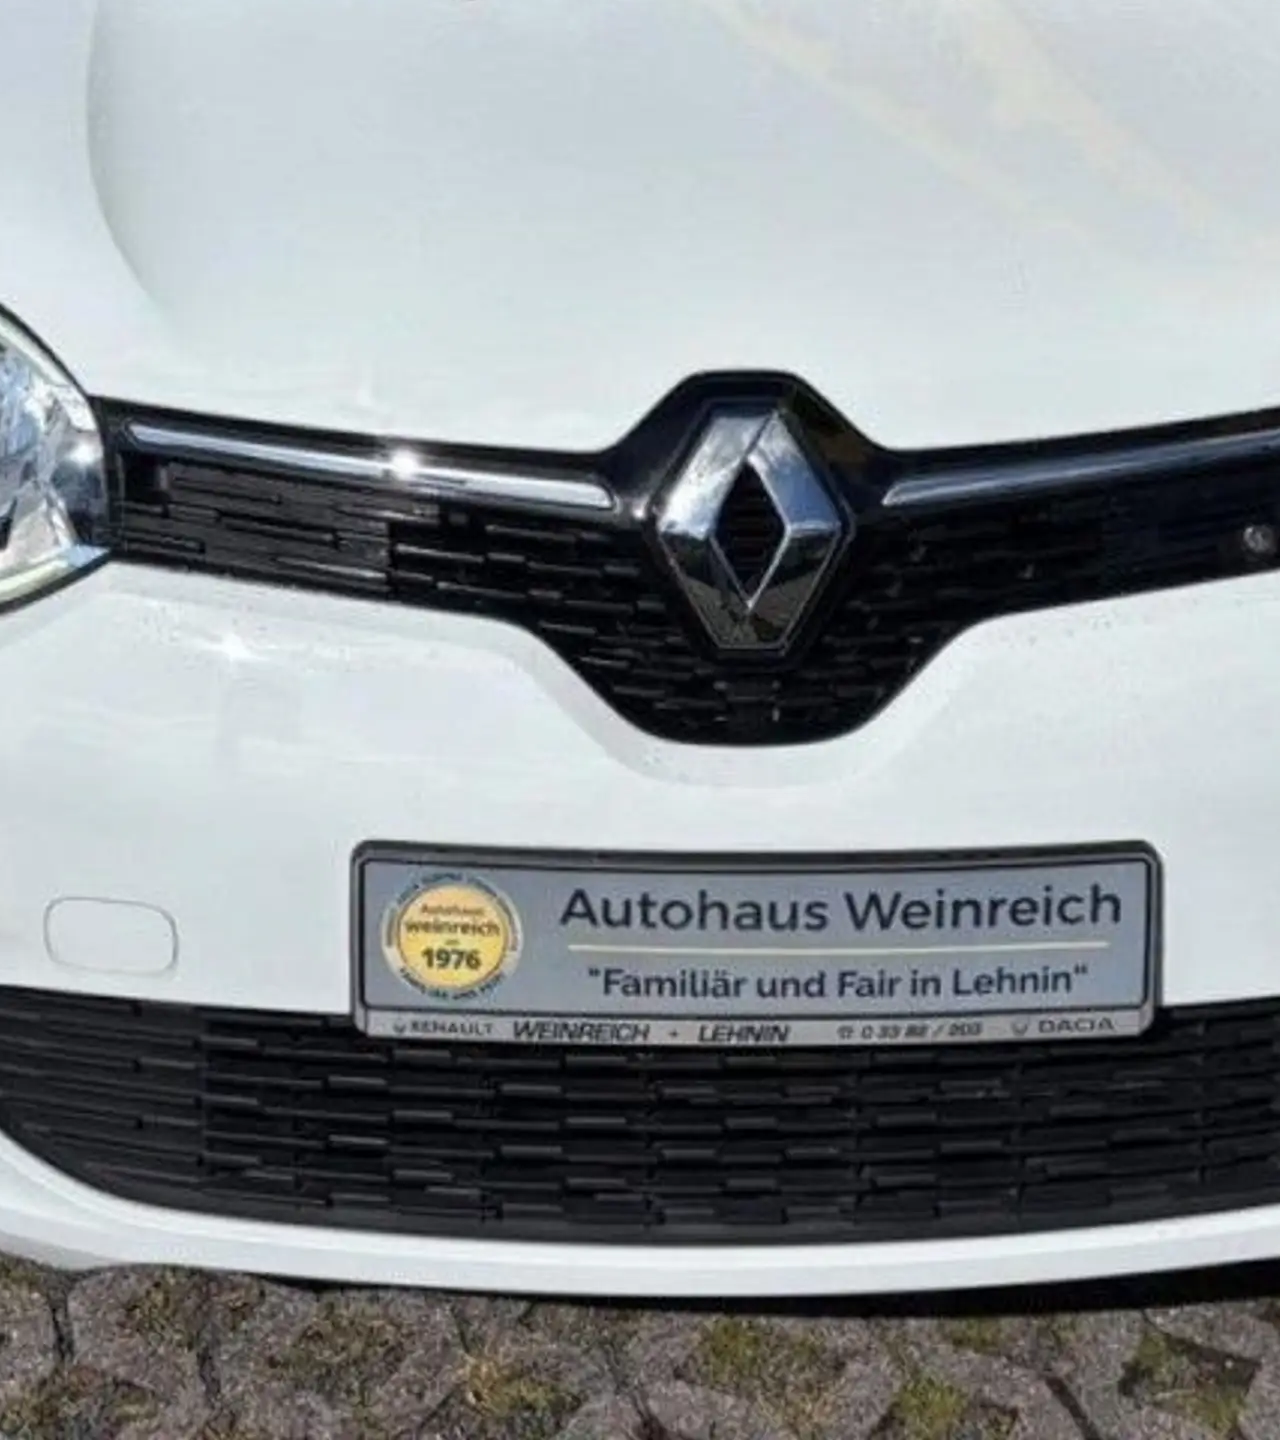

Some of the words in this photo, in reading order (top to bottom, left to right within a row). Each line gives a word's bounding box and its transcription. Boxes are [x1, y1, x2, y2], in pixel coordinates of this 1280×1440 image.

[560, 887, 829, 932] Autohaus
[843, 882, 1122, 931] Weinreich
[421, 947, 483, 971] 1976
[756, 970, 827, 999] und
[837, 969, 902, 998] Fair
[910, 967, 942, 998] in
[513, 1020, 650, 1043] WEINREICH
[697, 1023, 791, 1043] LEHNIN
[1038, 1016, 1115, 1034] DACIA
